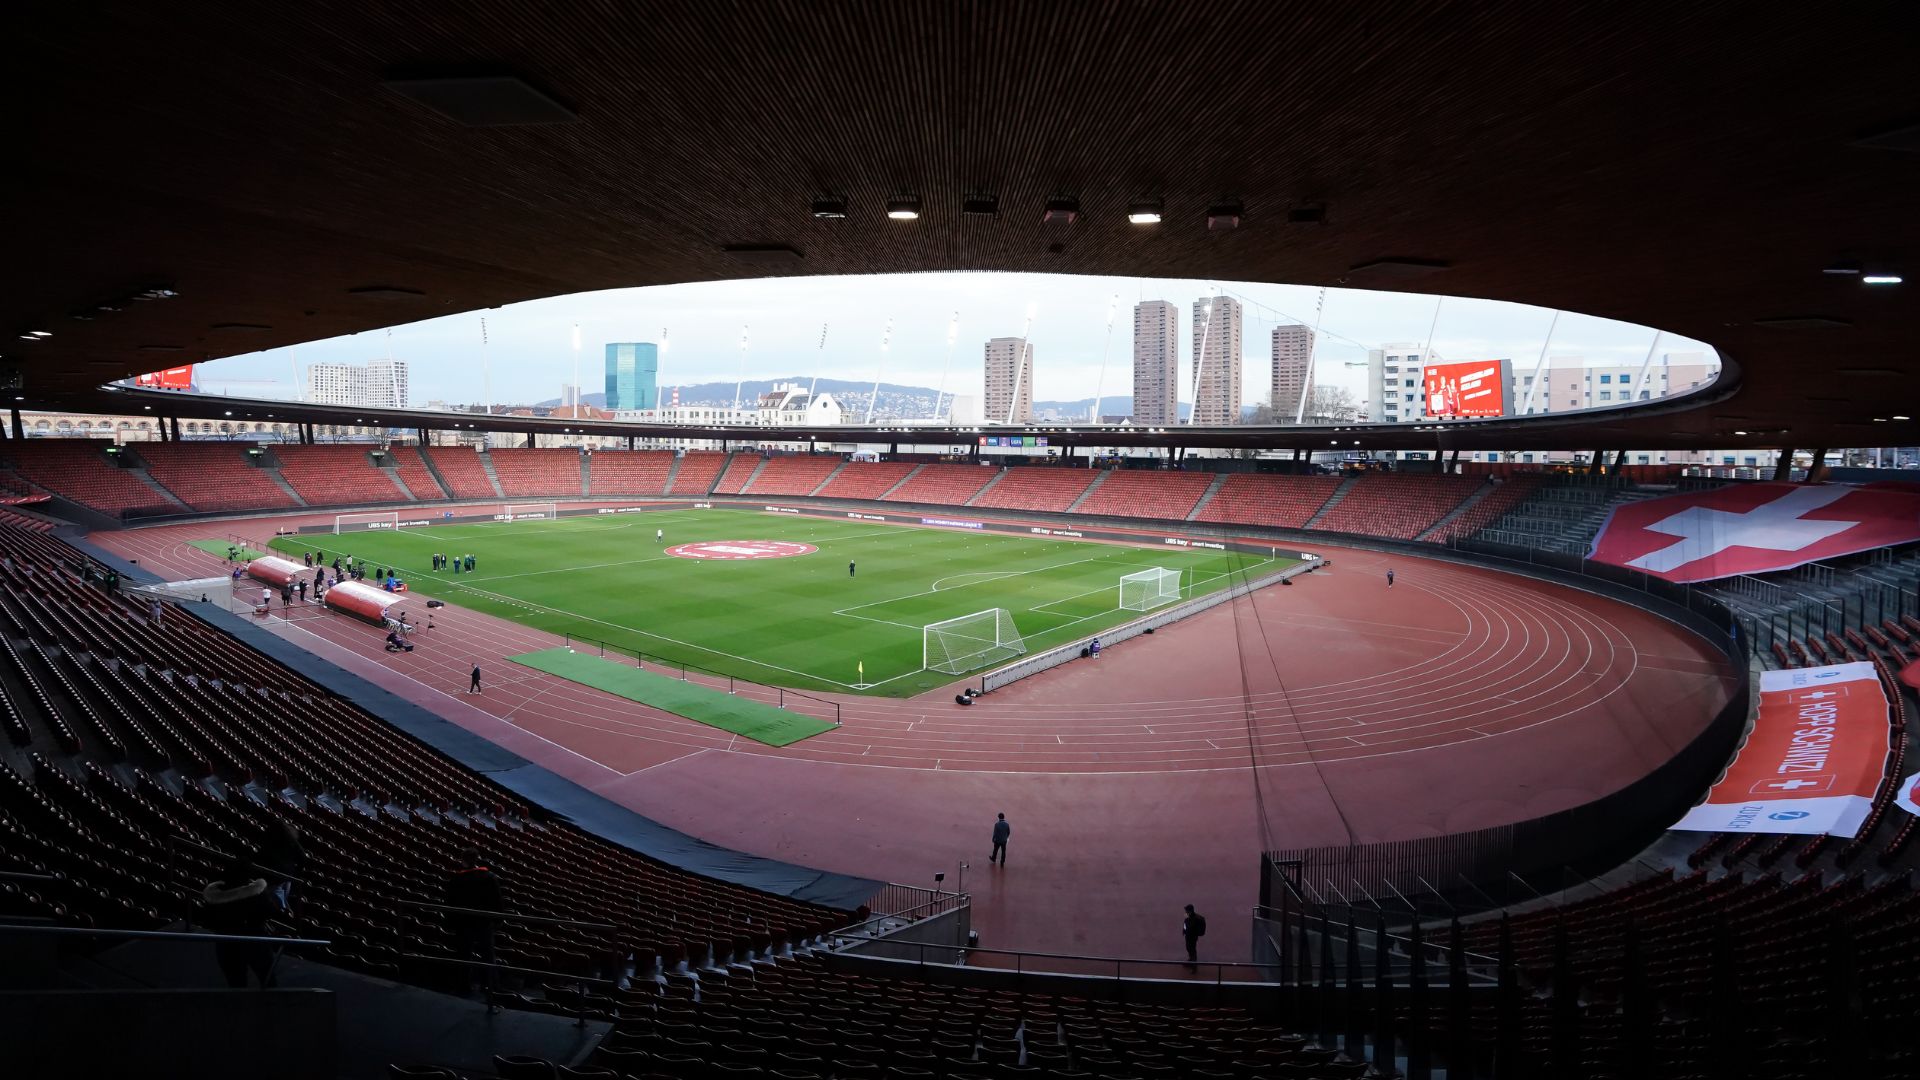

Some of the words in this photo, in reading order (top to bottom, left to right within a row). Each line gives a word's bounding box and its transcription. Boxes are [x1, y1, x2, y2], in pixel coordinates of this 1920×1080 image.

[1176, 538, 1188, 547] key
[1301, 552, 1313, 561] UBS
[1797, 701, 1838, 726] HOPP
